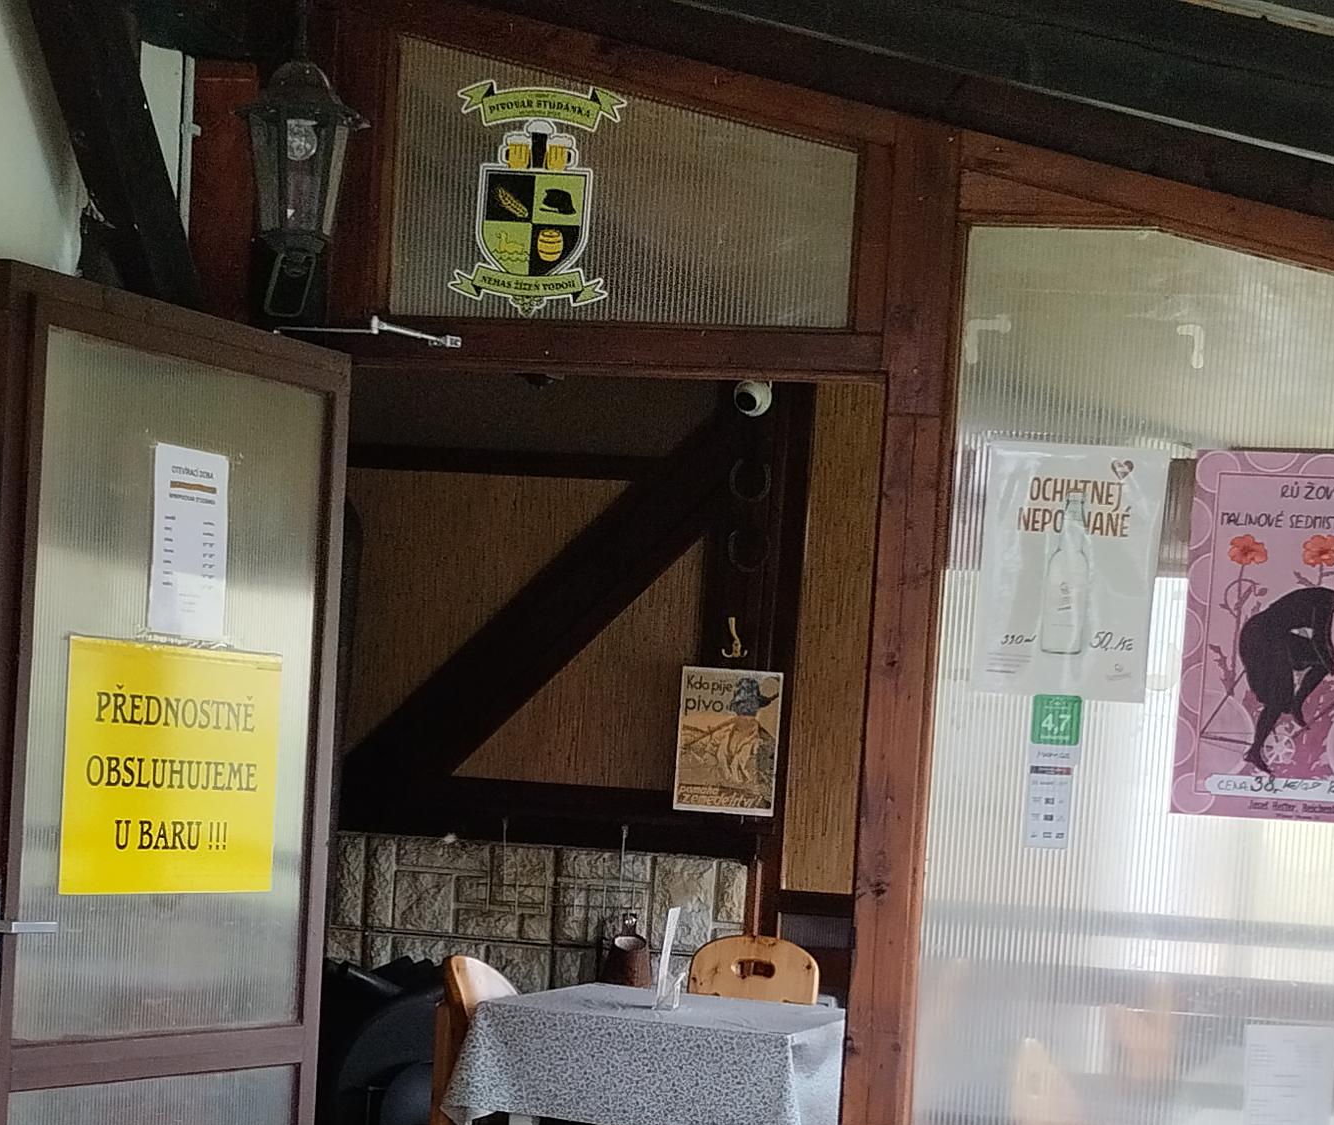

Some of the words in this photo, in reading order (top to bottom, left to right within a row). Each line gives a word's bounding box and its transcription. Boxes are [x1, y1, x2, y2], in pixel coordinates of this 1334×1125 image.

[489, 100, 534, 114] PIVOVAR
[1221, 510, 1284, 528] MALINOVÉ
[686, 675, 709, 690] Kdo
[711, 680, 733, 696] pije
[95, 684, 255, 733] PŘEDNOSTNĚ
[685, 696, 723, 716] pivo
[1041, 713, 1071, 734] 4,7
[86, 754, 258, 793] OBSLUHUJEME
[114, 820, 132, 851] U
[137, 820, 202, 851] BARU
[208, 821, 228, 851] !!!
